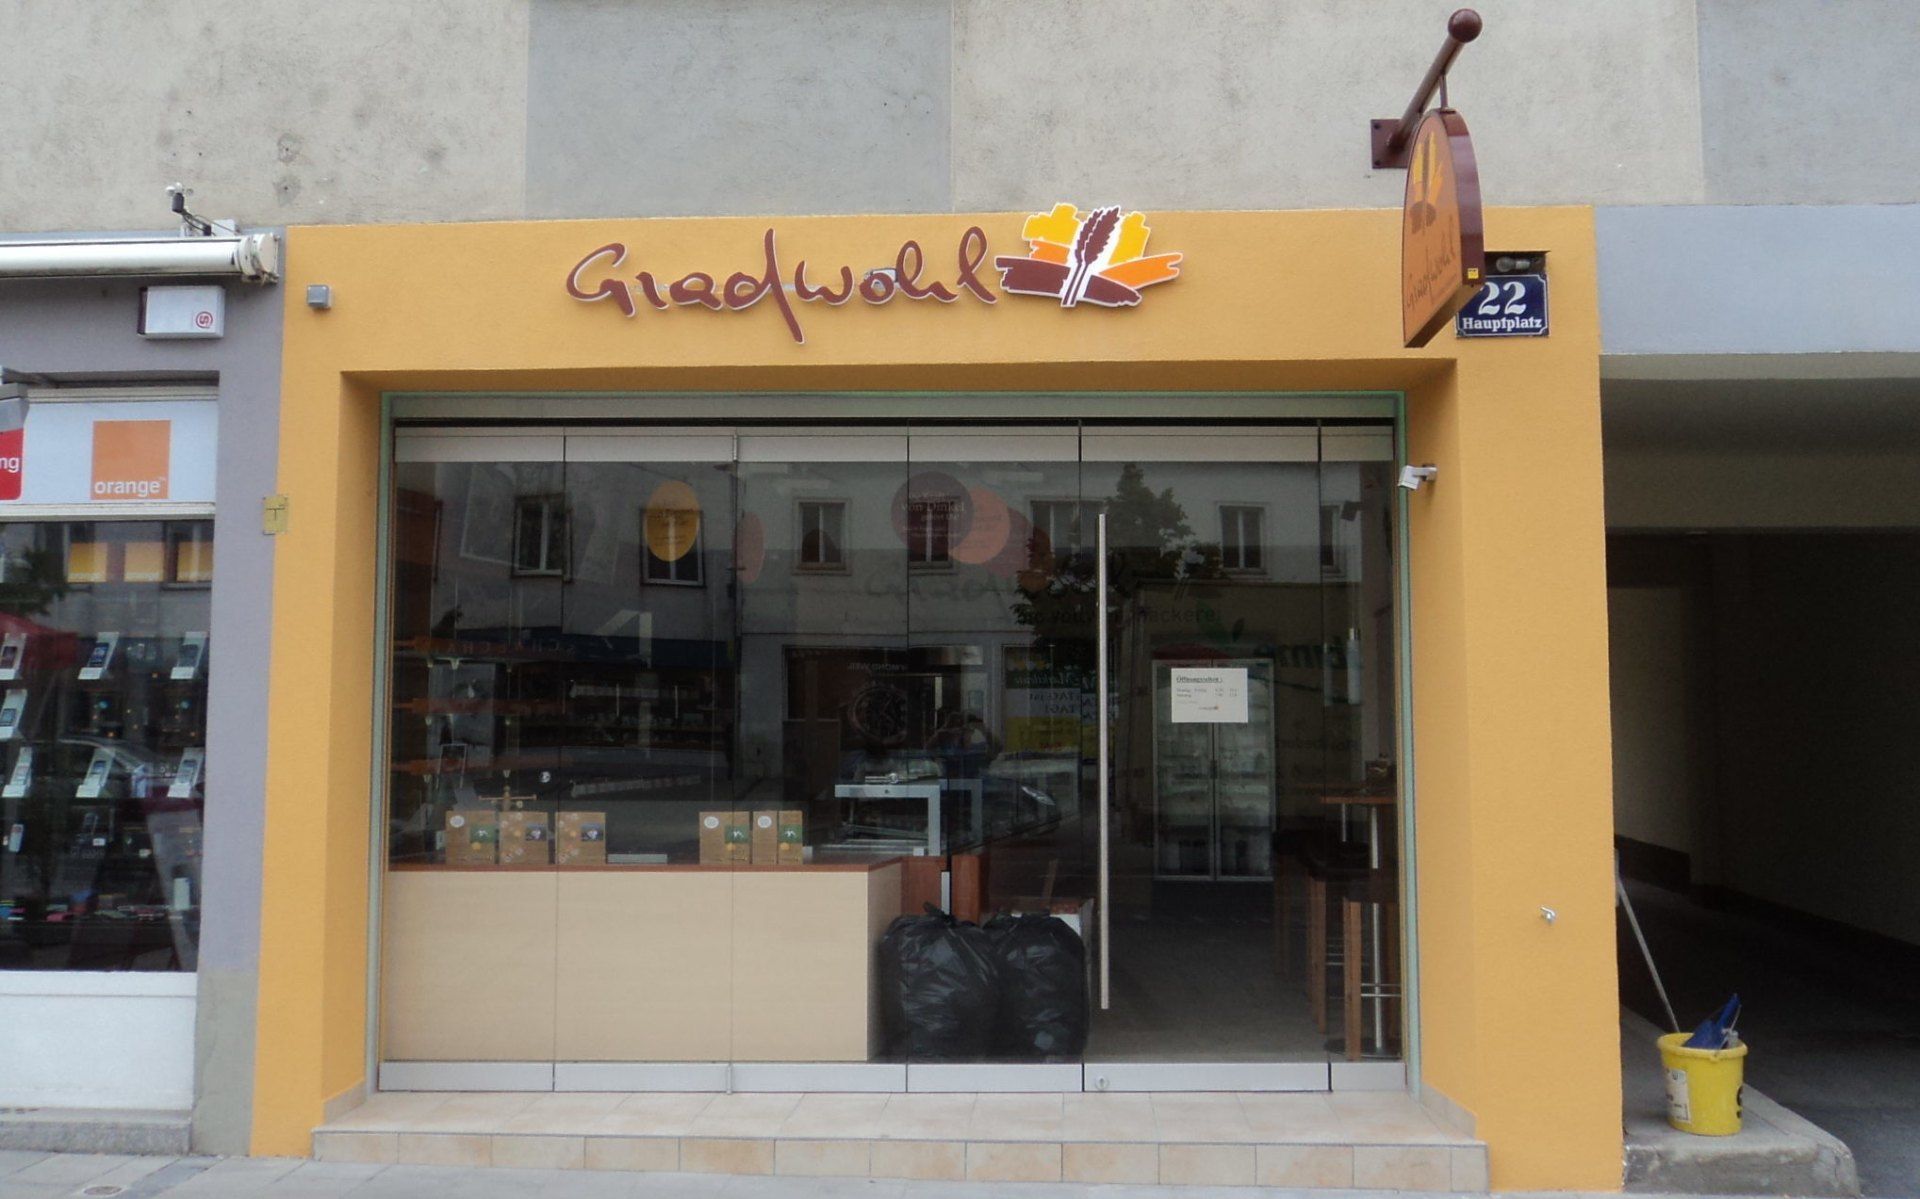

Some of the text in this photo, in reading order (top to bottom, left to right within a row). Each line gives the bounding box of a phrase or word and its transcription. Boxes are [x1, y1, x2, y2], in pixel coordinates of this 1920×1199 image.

[566, 226, 997, 345] Gradwohl
[1478, 281, 1527, 316] 22
[1462, 316, 1543, 332] Hauptplatz
[94, 480, 161, 497] orange
